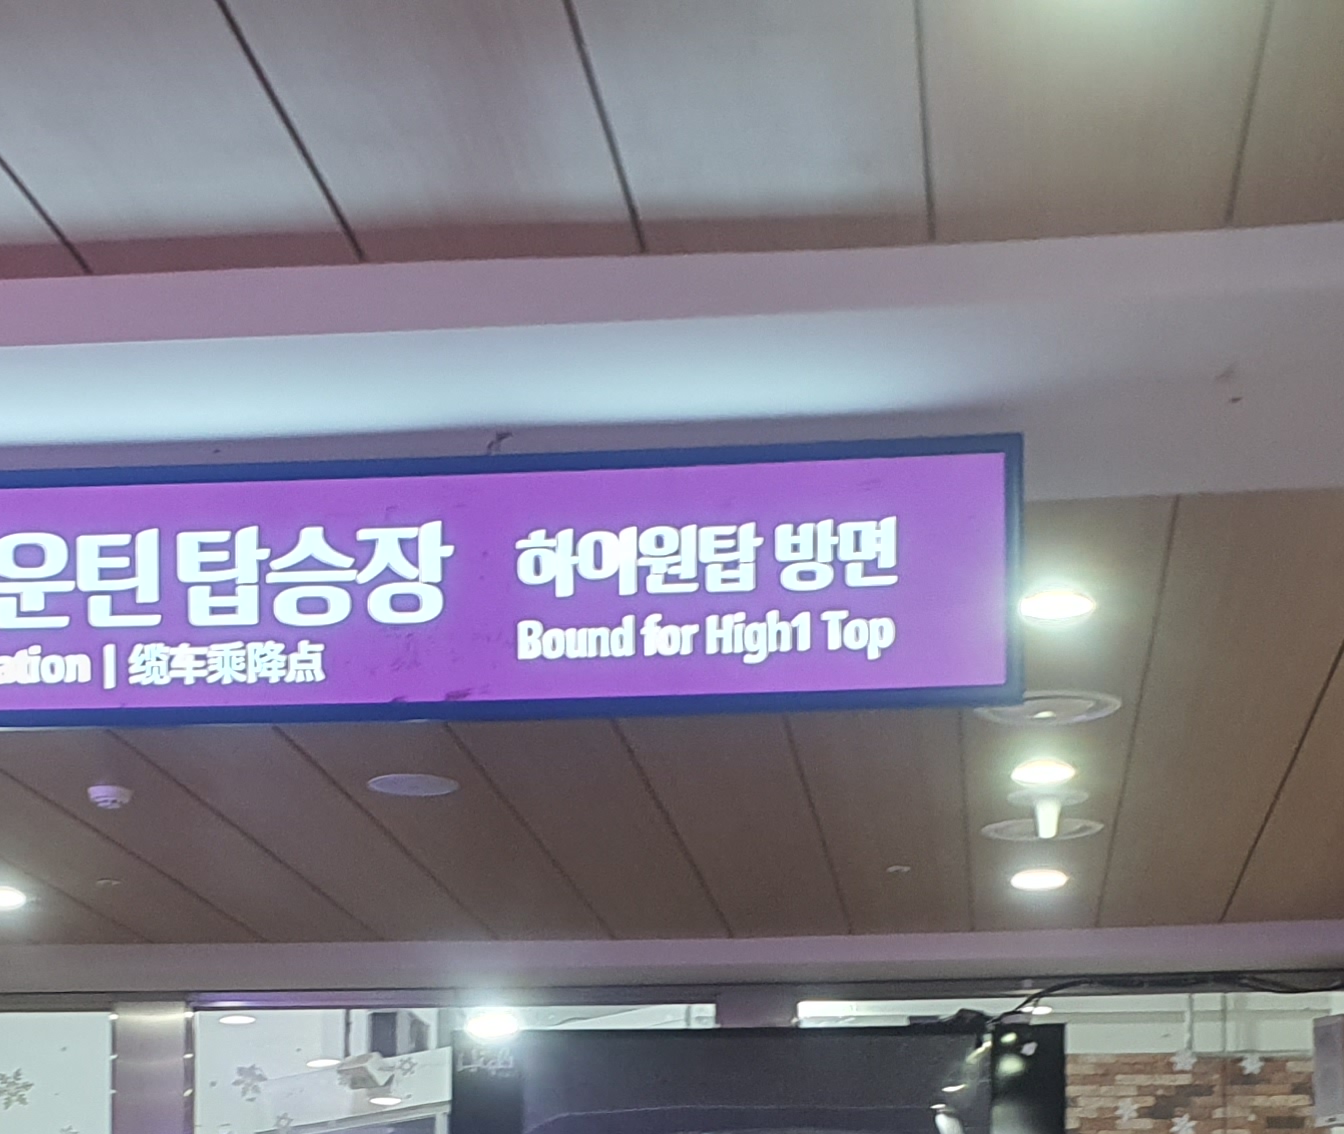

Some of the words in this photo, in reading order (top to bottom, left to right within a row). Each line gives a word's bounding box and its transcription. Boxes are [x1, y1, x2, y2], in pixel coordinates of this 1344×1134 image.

[176, 520, 455, 626] 탑승장
[515, 522, 764, 598] 하이원탑
[774, 515, 899, 592] 방면
[127, 639, 326, 686] 缆车乘降点
[517, 614, 636, 660] Bound
[640, 612, 700, 657] for
[705, 609, 811, 664] High1
[820, 609, 896, 660] Top
